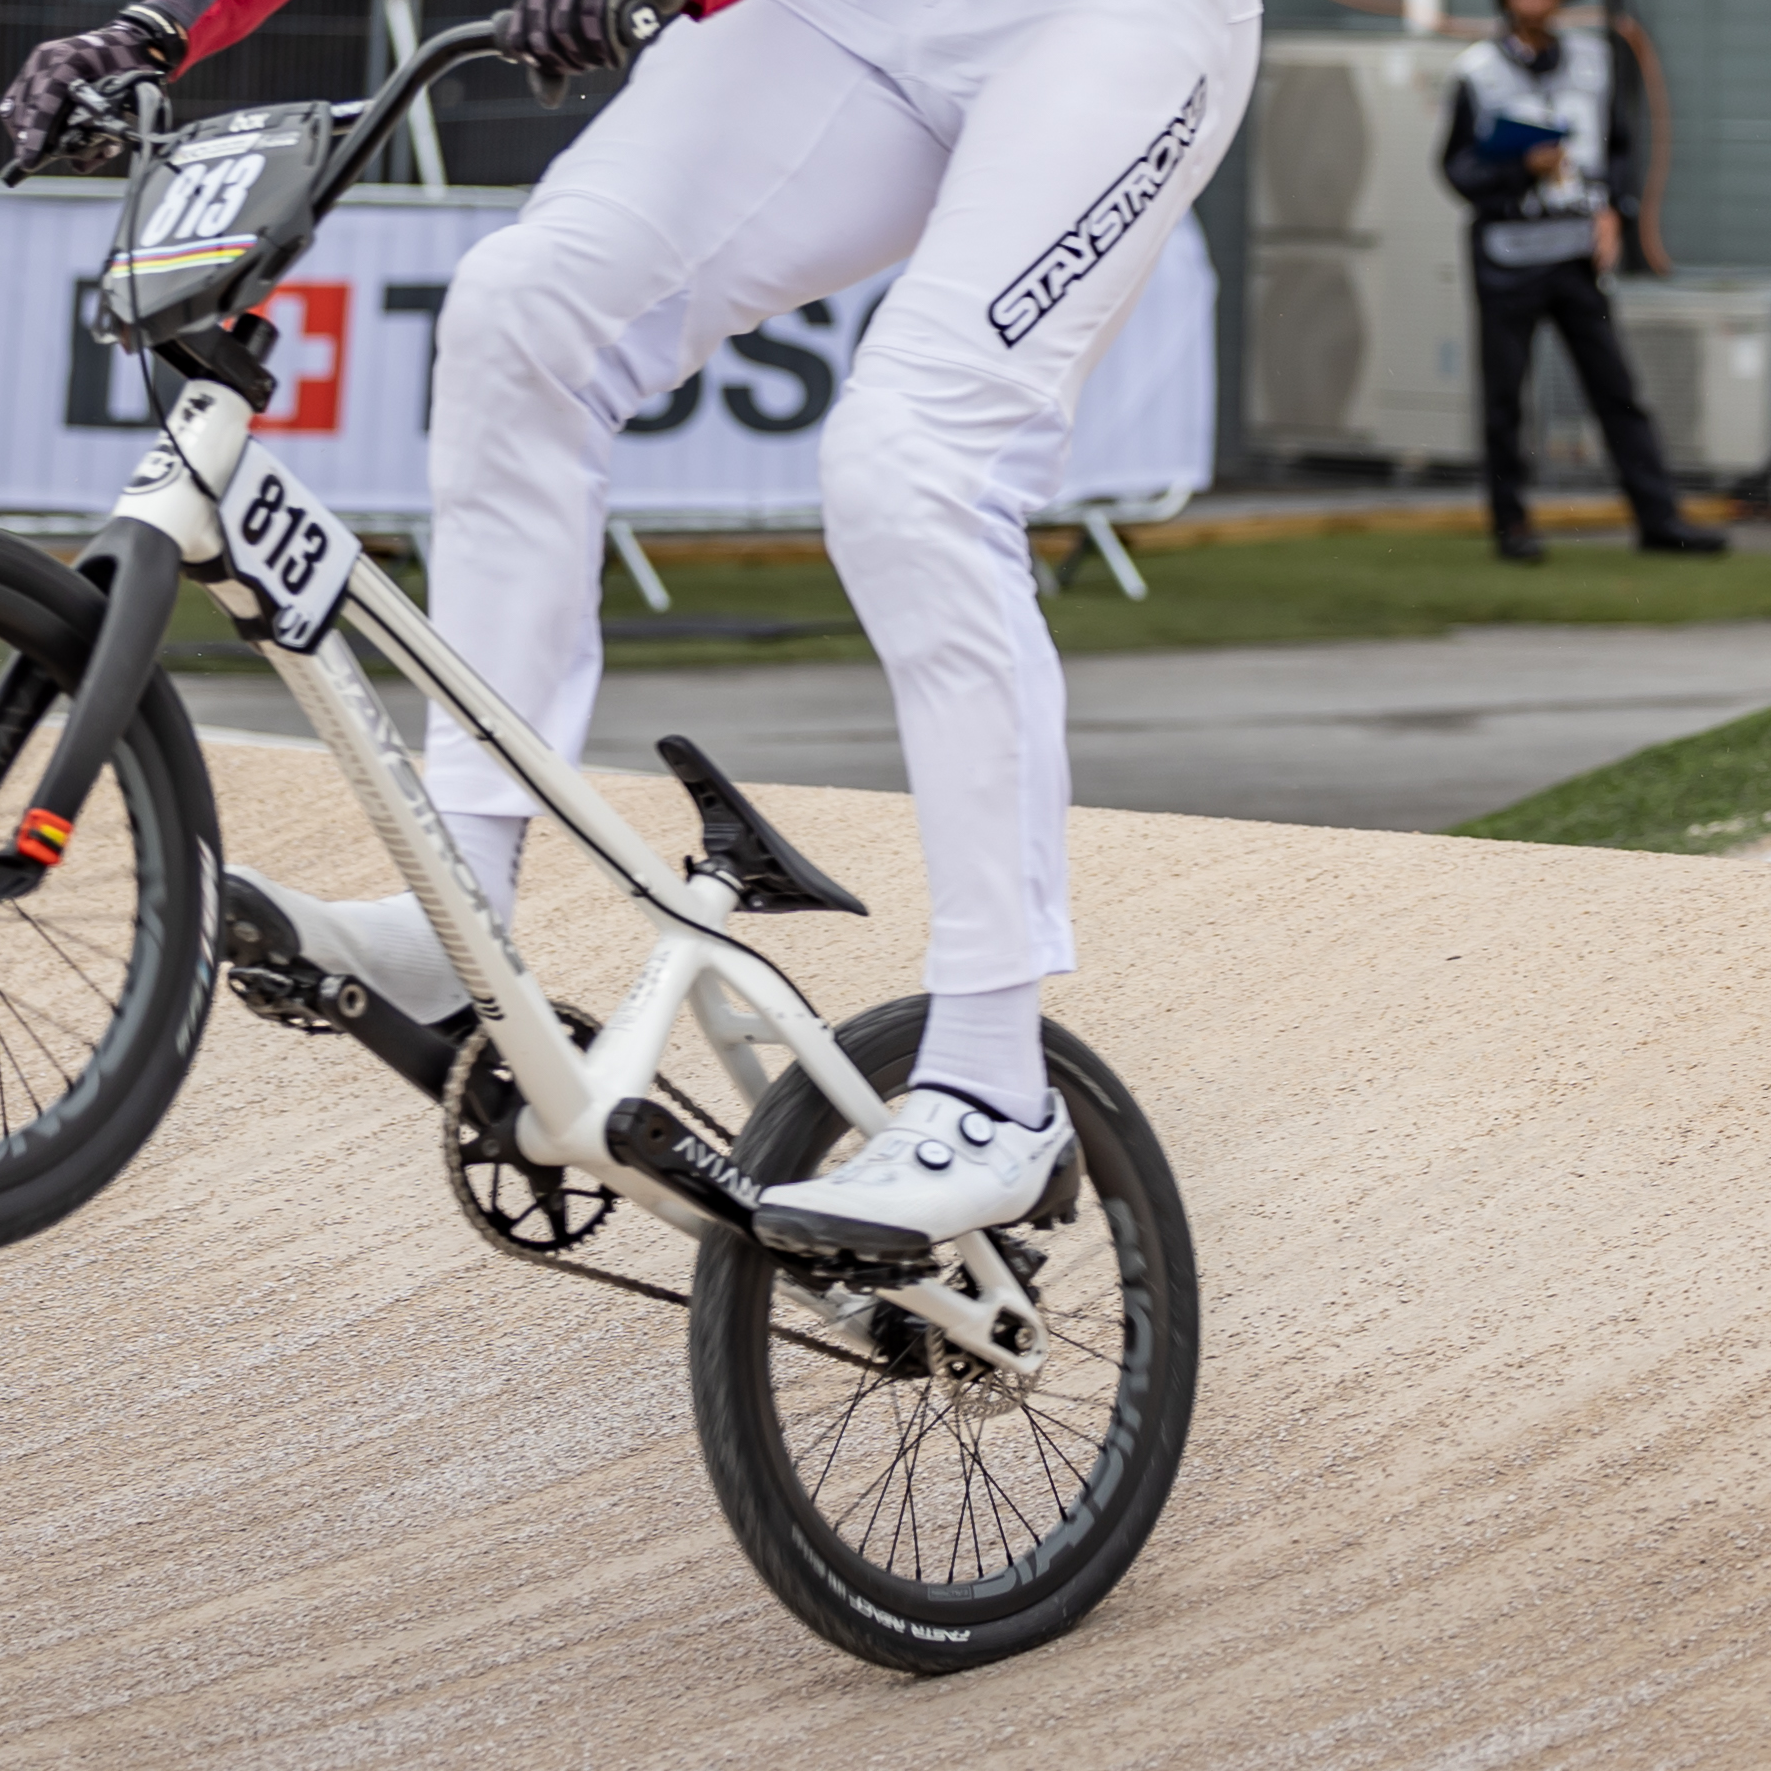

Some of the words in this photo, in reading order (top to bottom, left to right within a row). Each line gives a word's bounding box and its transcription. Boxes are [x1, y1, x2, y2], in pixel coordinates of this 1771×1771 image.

[139, 153, 267, 247] 813
[240, 473, 329, 597] 813
[673, 1133, 763, 1211] AVIAN
